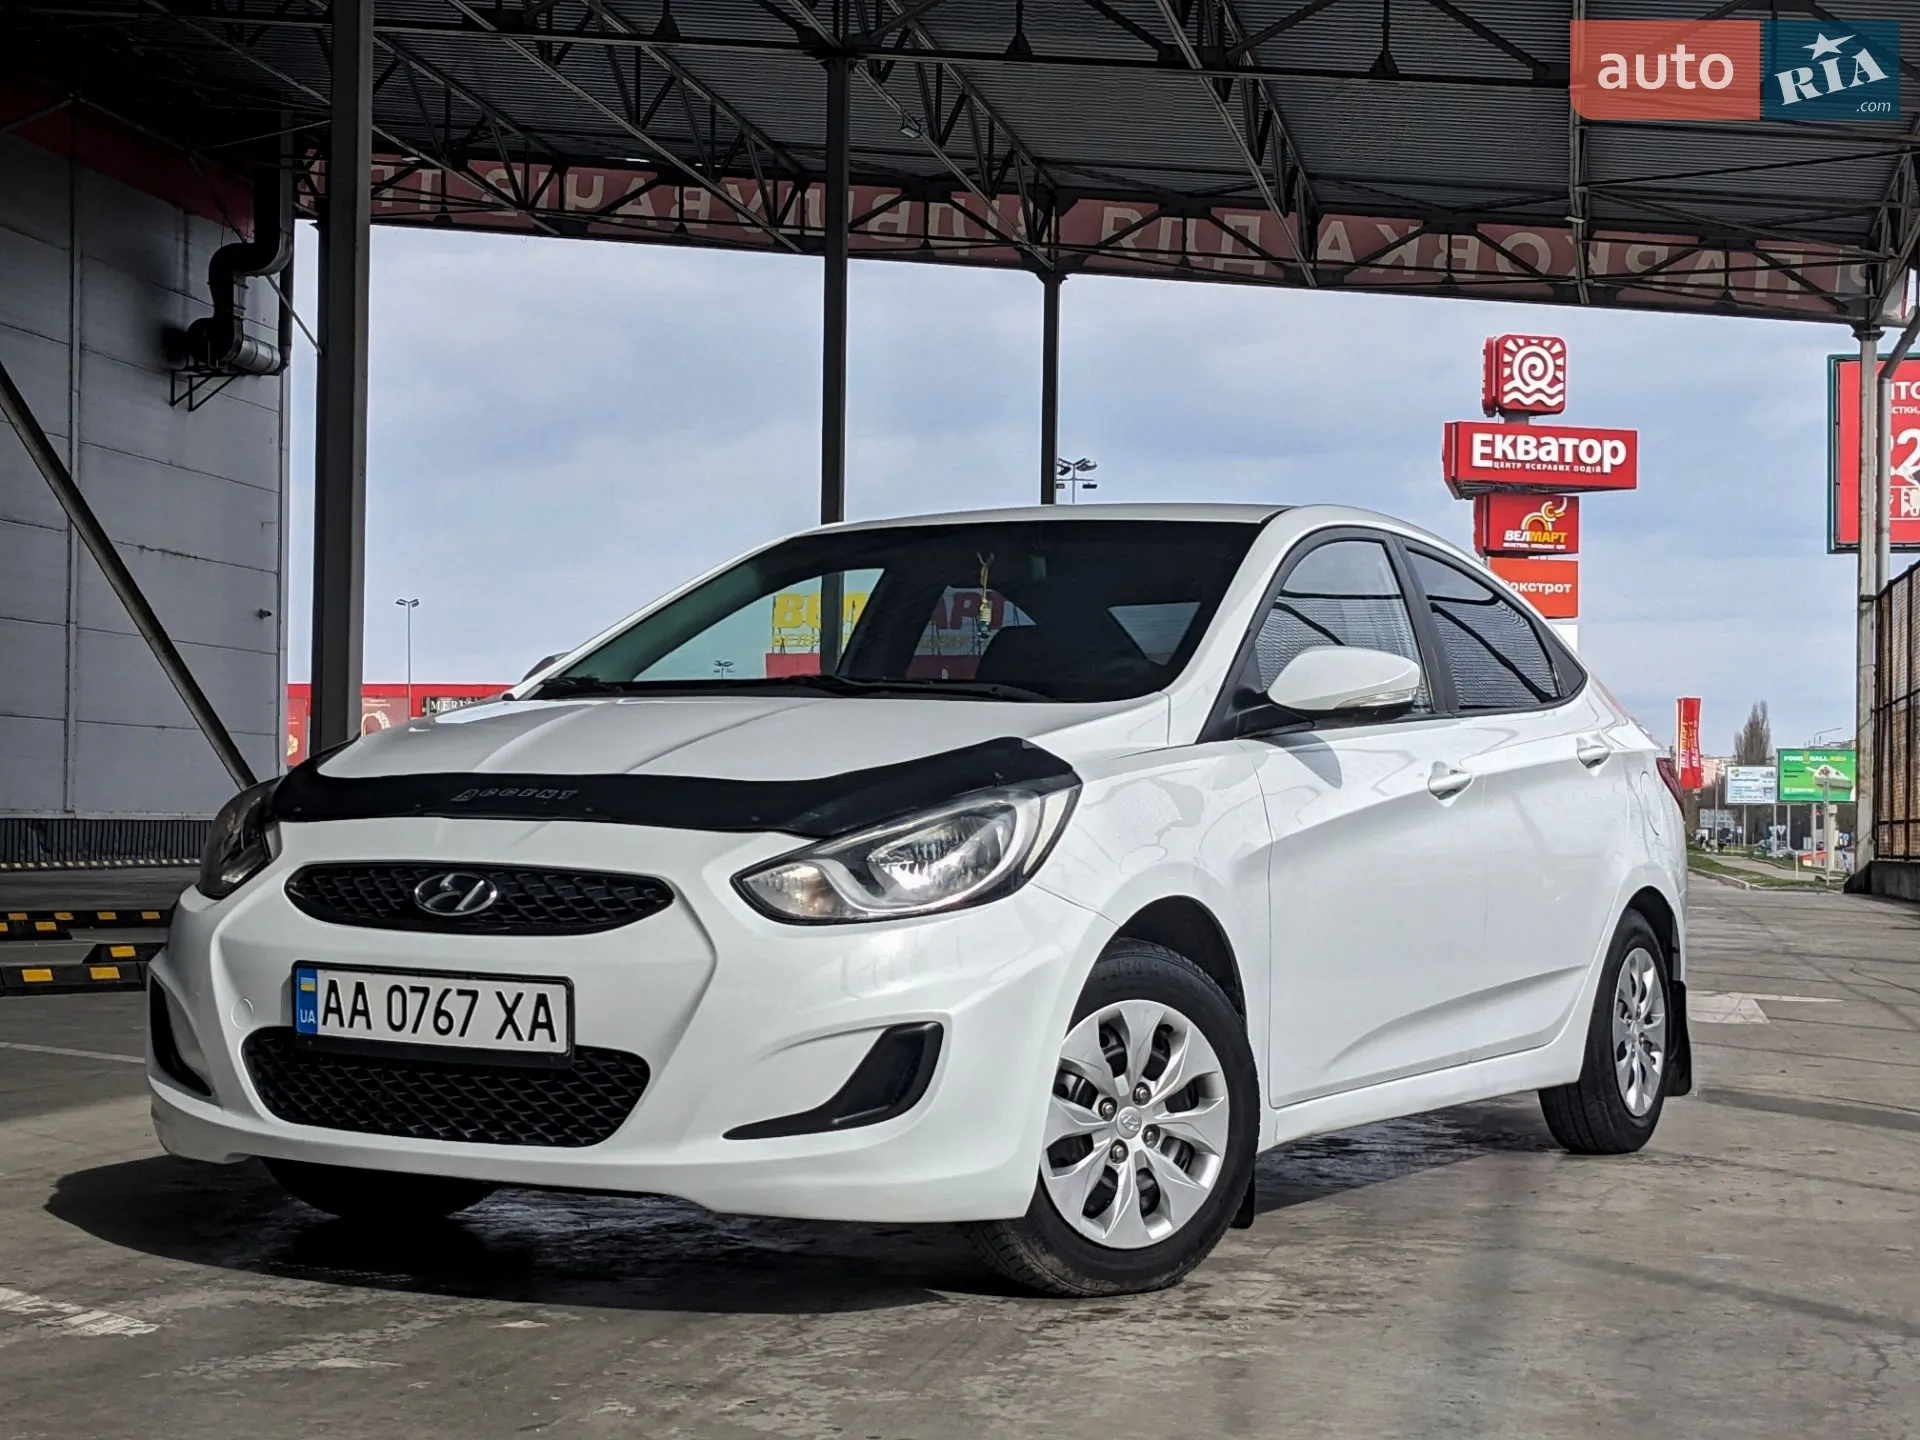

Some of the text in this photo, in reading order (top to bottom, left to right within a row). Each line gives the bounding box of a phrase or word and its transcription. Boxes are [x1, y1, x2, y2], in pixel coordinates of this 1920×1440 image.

[1494, 462, 1601, 474] ЦЕНТР ЯСКРАВИХ ПОДІЙ
[1504, 529, 1568, 544] ВЕЛМАРТ
[1505, 580, 1573, 596] окстрот
[300, 1009, 316, 1024] UA
[321, 978, 557, 1043] AA 0767 XA
